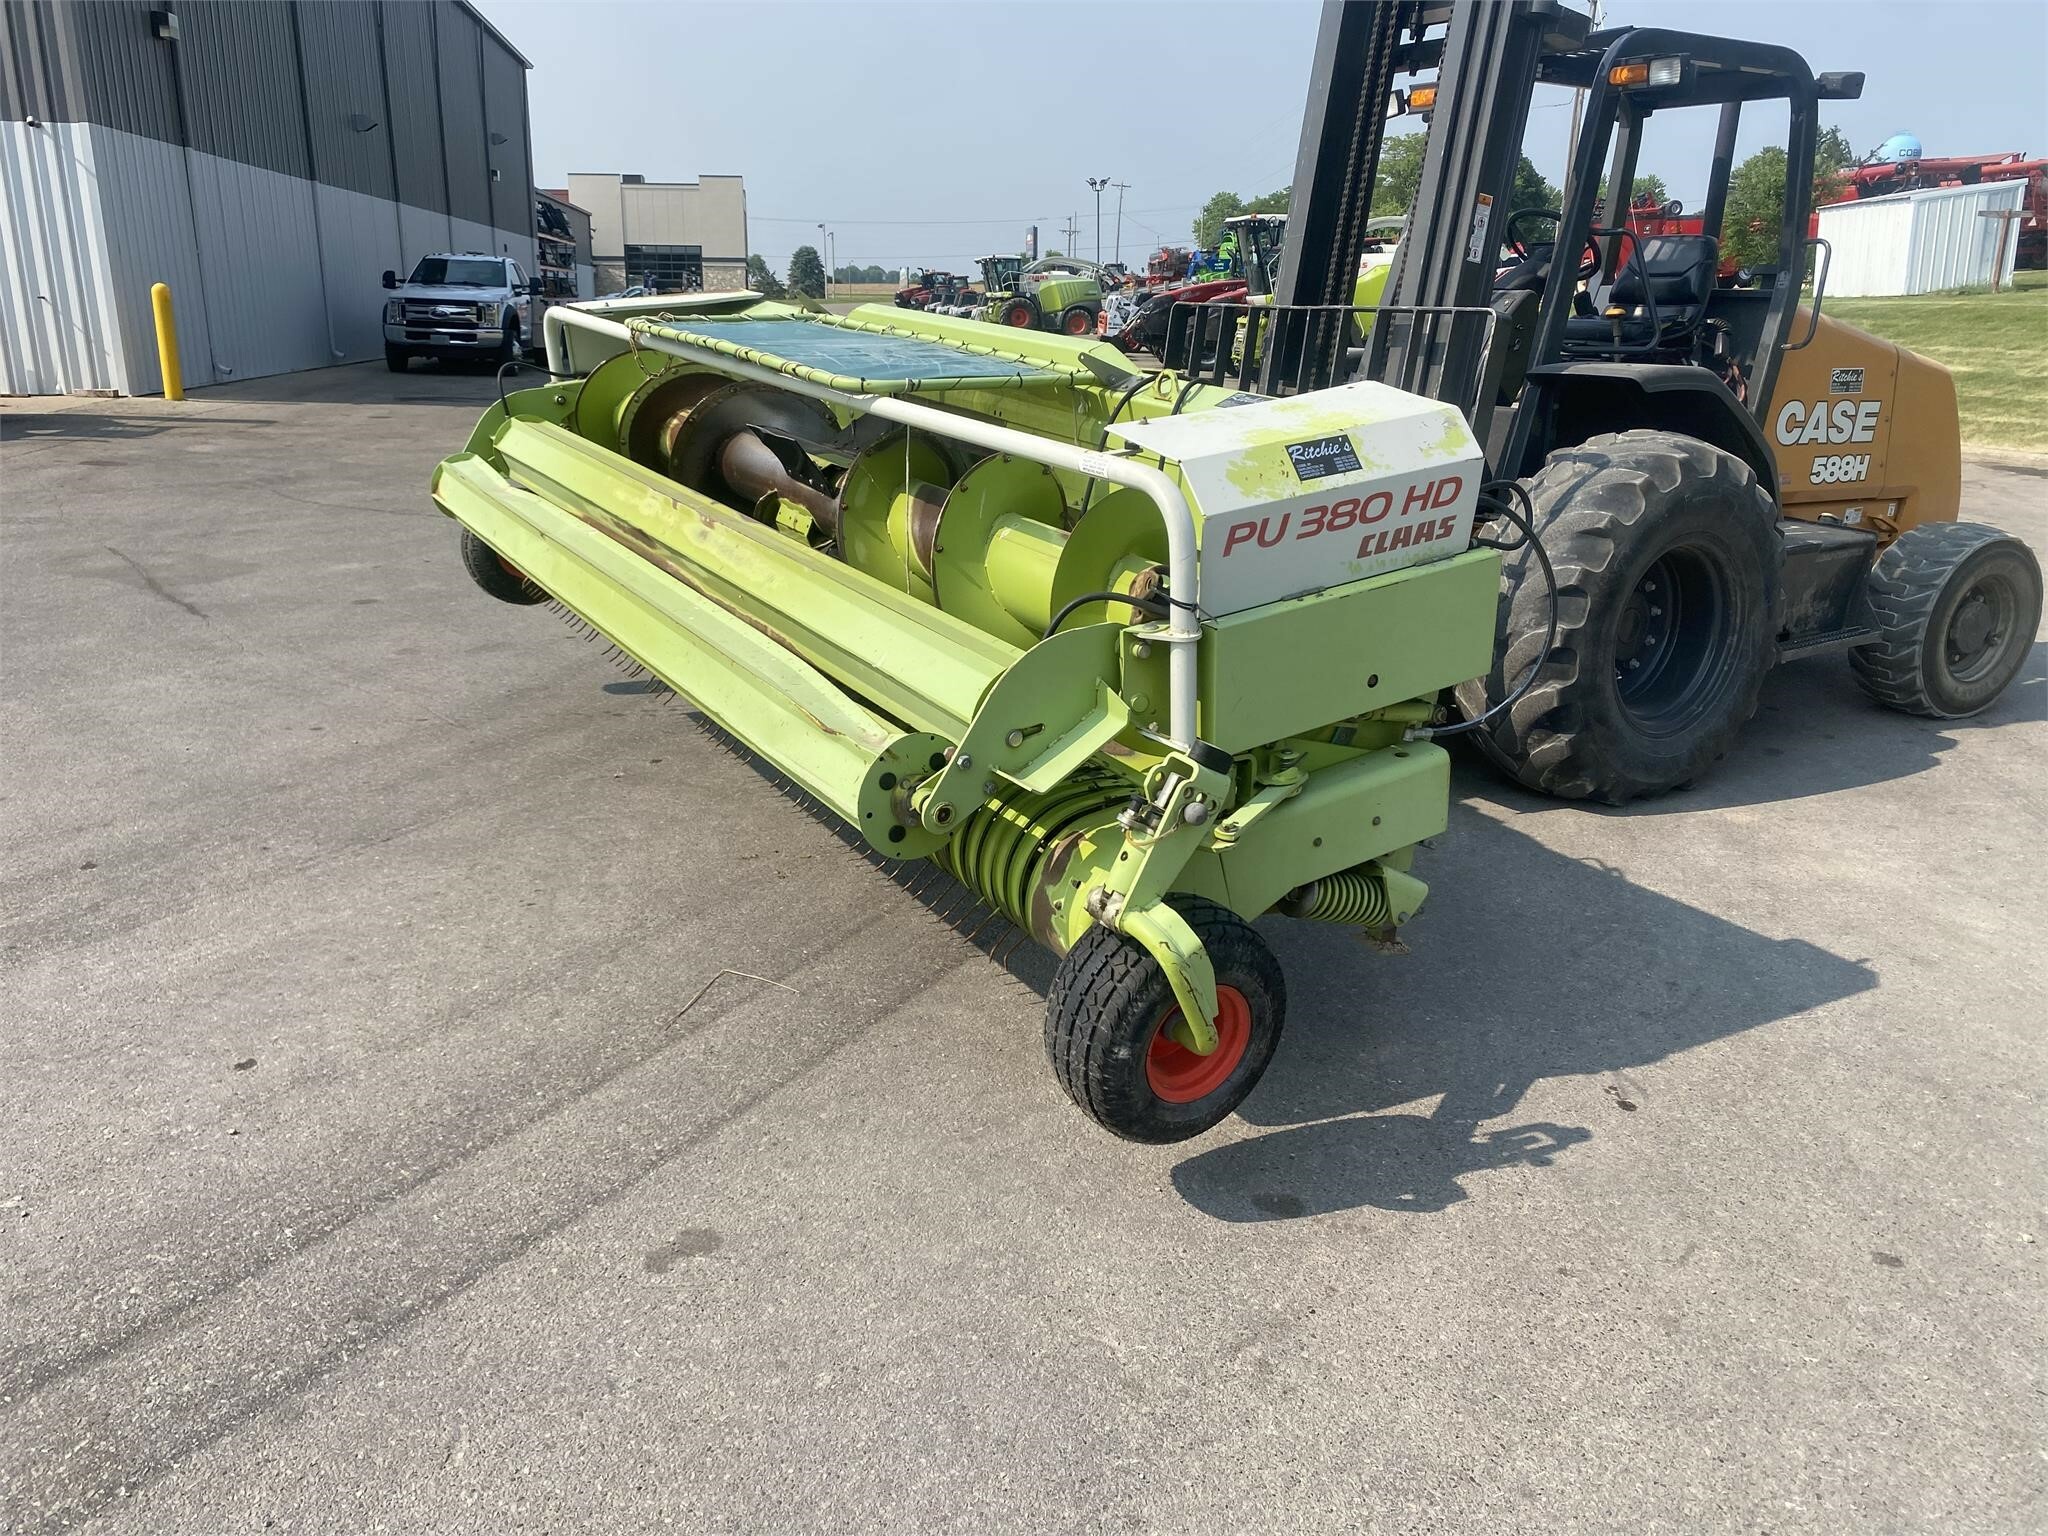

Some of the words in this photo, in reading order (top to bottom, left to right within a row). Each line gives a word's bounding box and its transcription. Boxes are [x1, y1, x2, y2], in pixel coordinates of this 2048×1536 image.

[1832, 370, 1862, 382] Ritchie's
[1776, 399, 1882, 446] CASE
[1288, 437, 1352, 463] Ritchie's
[1809, 454, 1871, 484] 588H
[1222, 513, 1291, 558] PU
[1296, 491, 1393, 540] 380
[1400, 476, 1463, 516] HD
[1357, 515, 1457, 559] CLAAS
